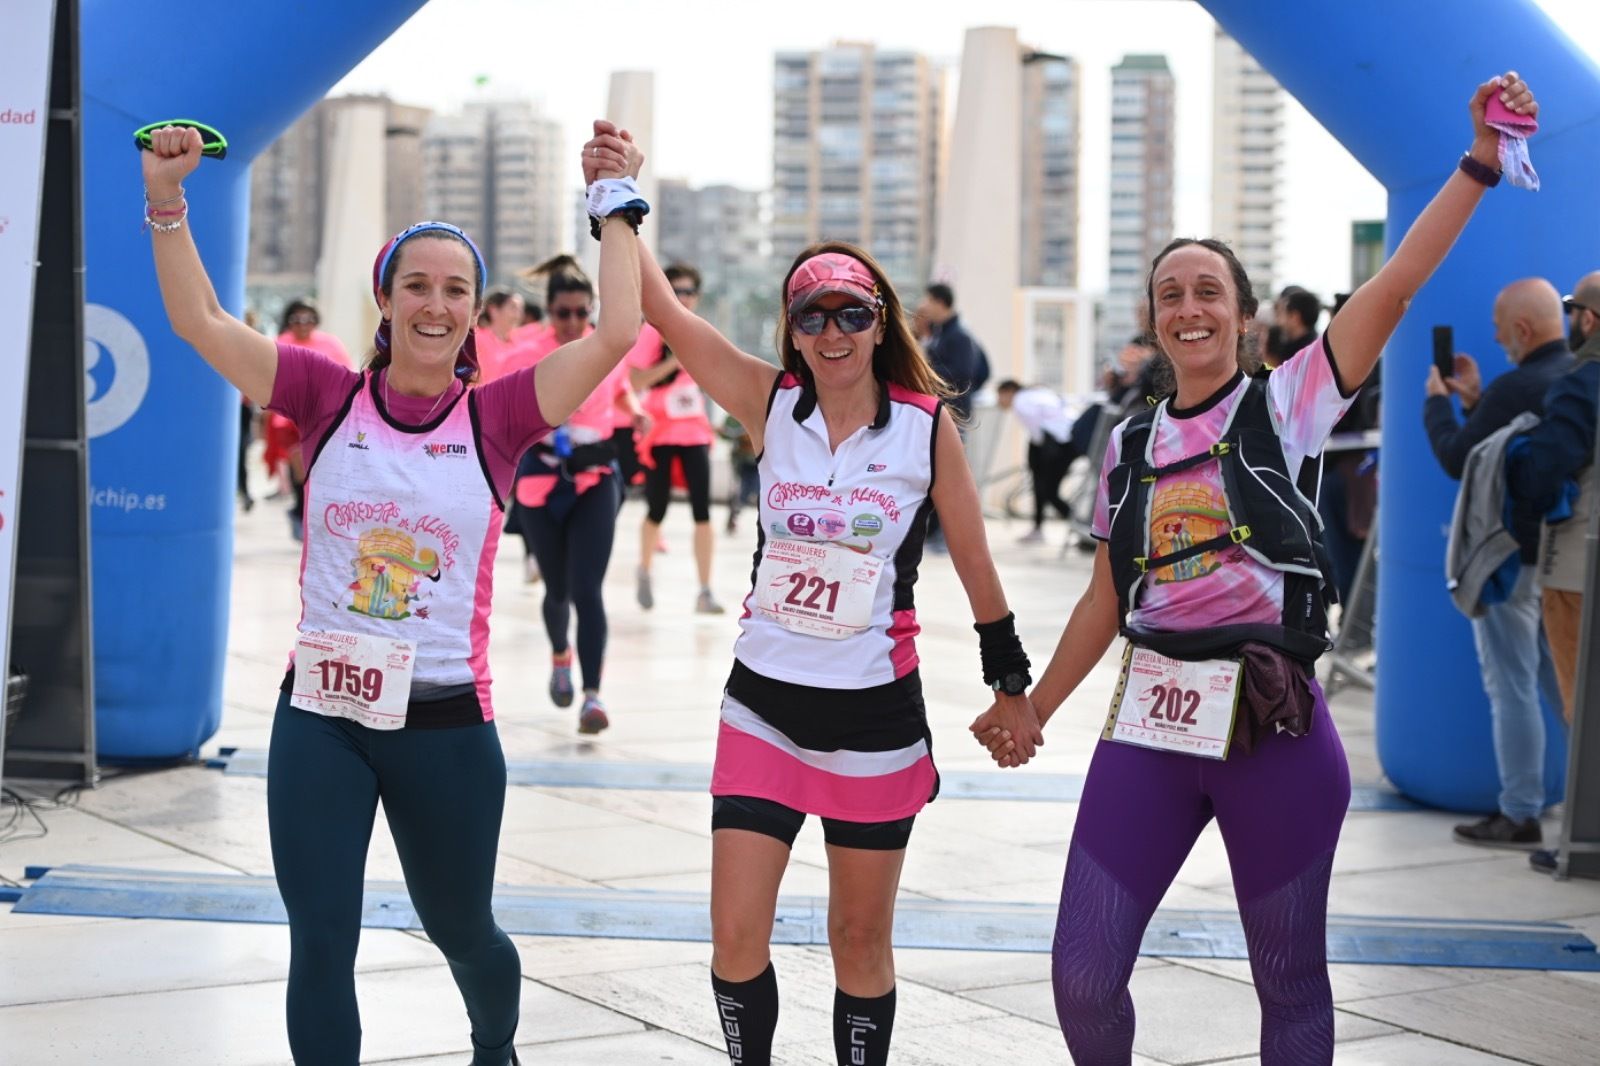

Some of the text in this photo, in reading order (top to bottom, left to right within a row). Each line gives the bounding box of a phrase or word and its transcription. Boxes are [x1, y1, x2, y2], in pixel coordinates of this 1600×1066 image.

[430, 443, 467, 455] werun
[784, 572, 840, 613] 221
[316, 659, 384, 702] 1759
[1149, 684, 1201, 726] 202
[846, 1013, 878, 1066] enji
